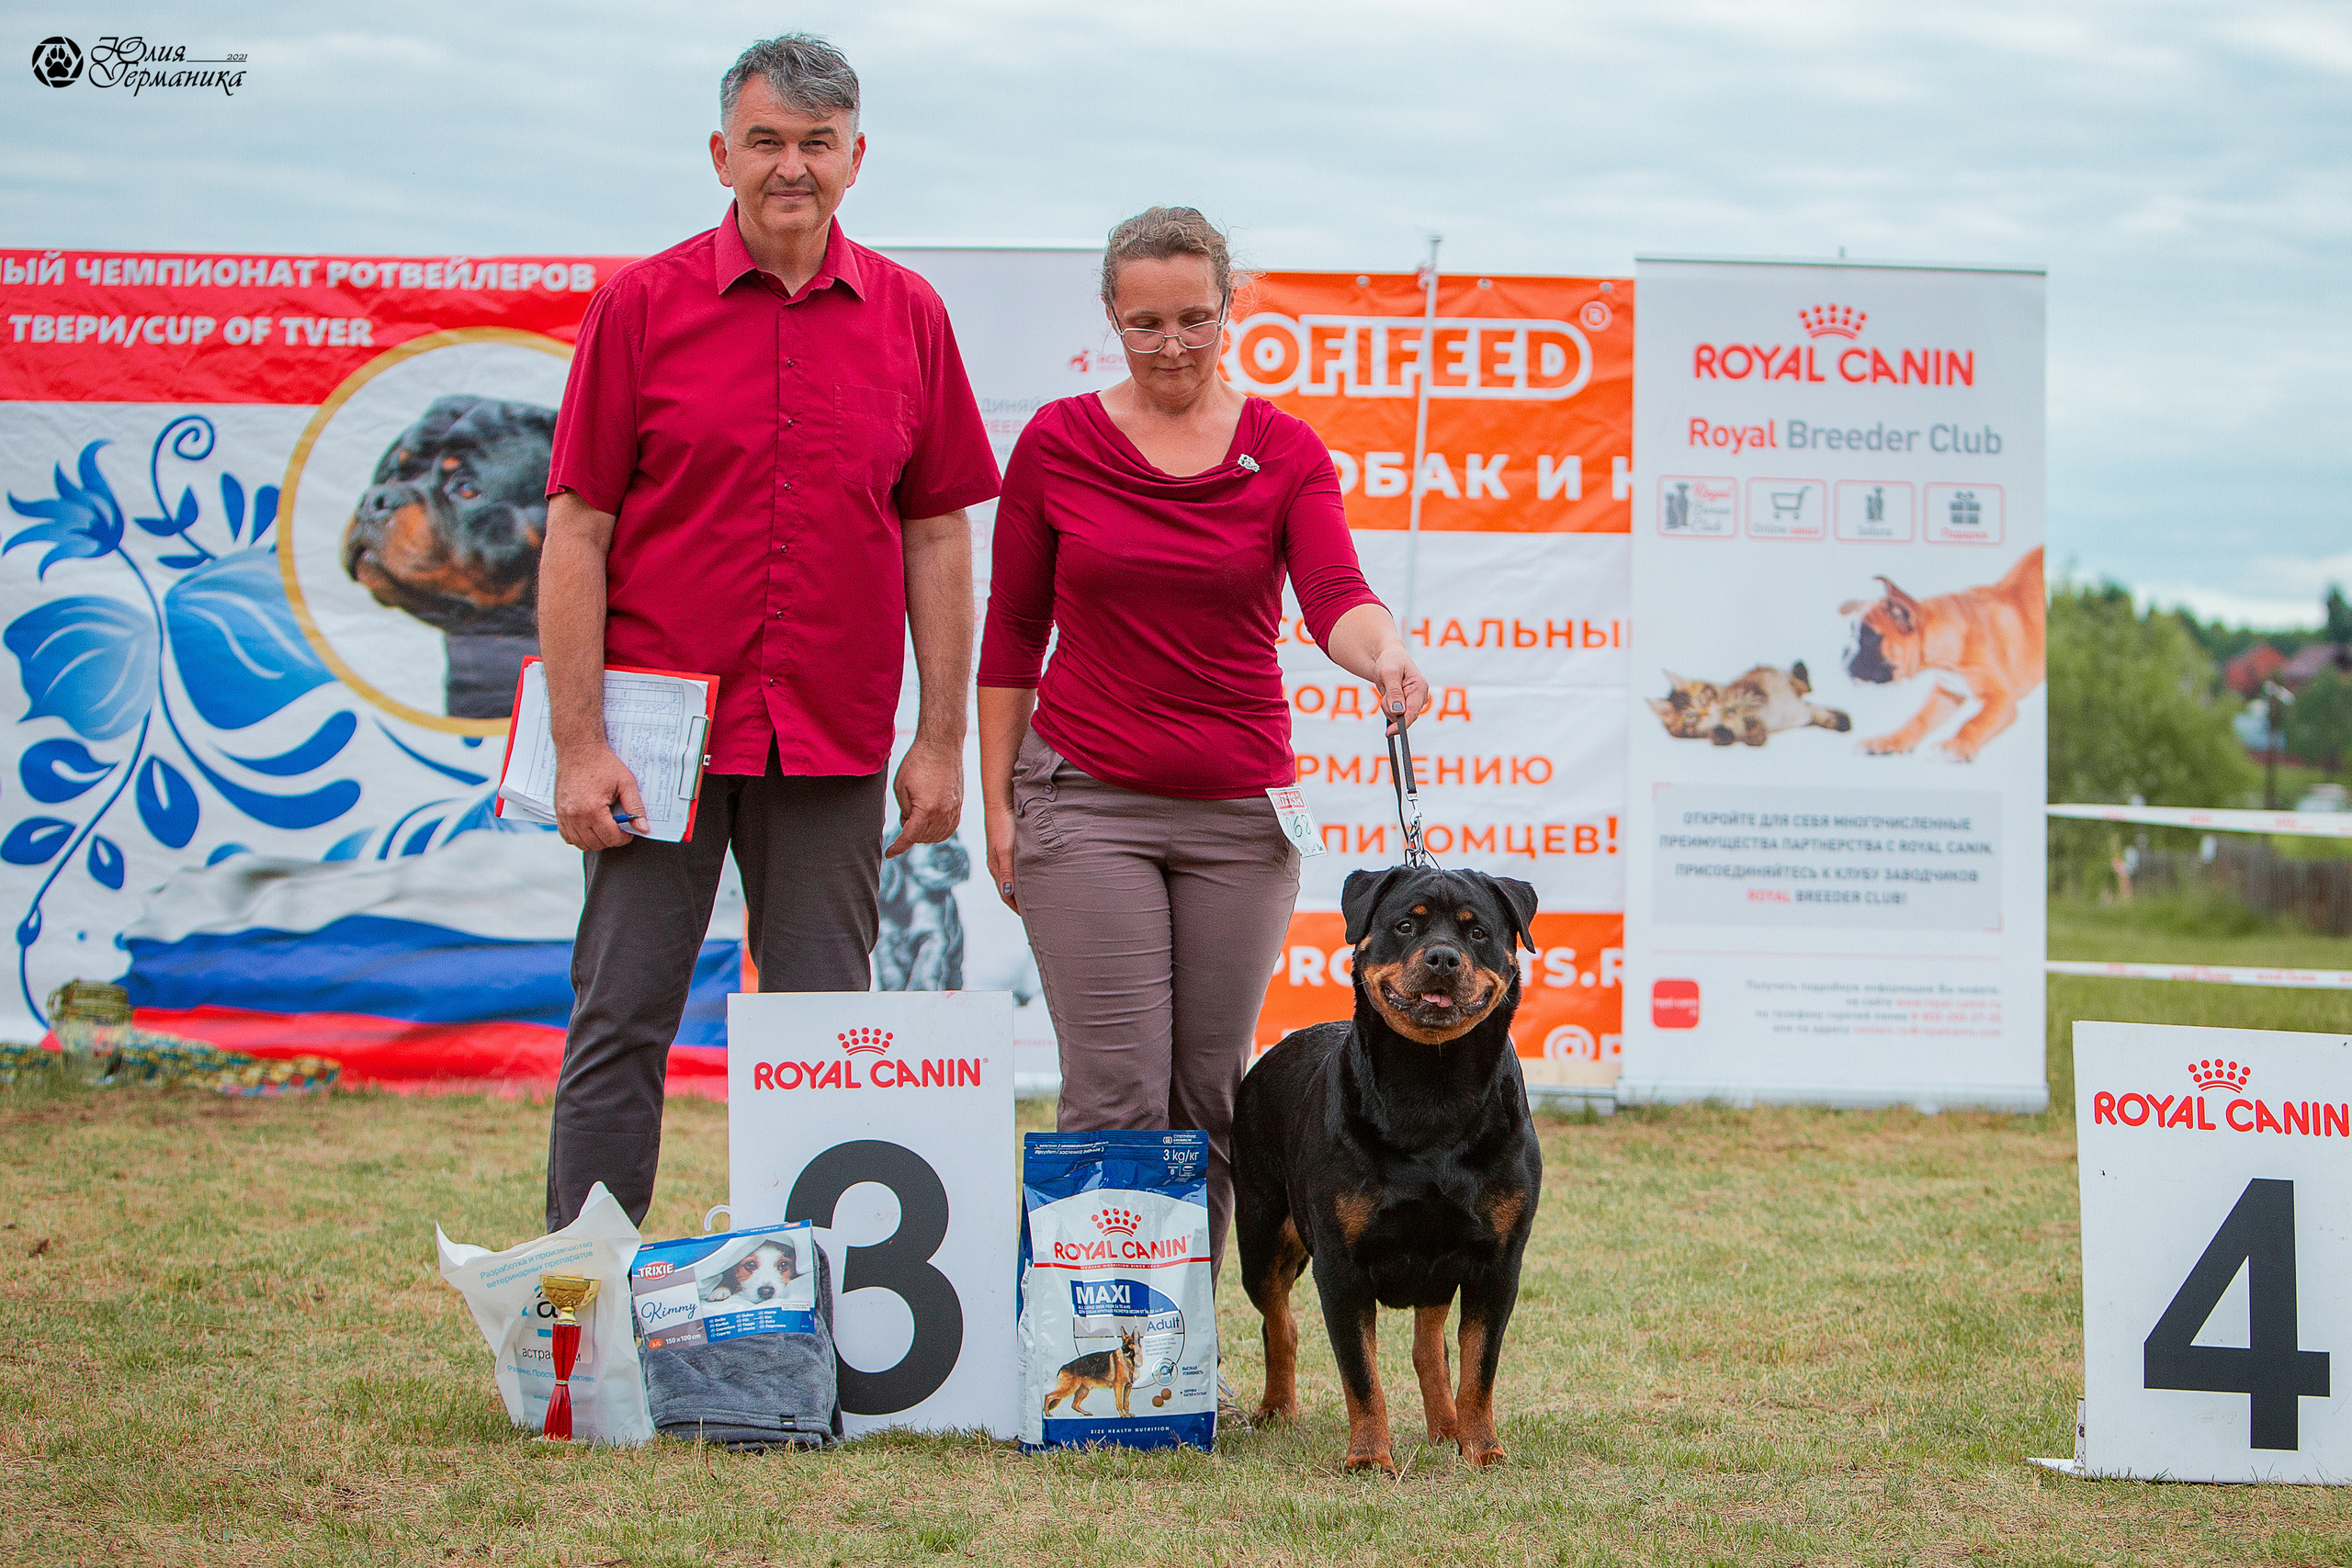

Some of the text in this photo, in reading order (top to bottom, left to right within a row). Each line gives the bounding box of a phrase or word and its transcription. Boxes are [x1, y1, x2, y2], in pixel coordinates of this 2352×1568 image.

[0, 250, 596, 292] ЫЙ ЧЕМПИОНАТ РОТВЕЙЛЕРОВ
[223, 316, 272, 345] OF
[279, 317, 374, 347] TVER
[1694, 343, 1974, 388] ROYAL CANIN
[1689, 417, 2003, 455] Royal Breeder Club
[1537, 455, 1583, 501] И
[1295, 754, 1554, 785] РМЛЕНИЮ
[754, 1057, 981, 1090] ROYAL CANIN
[2094, 1090, 2350, 1138] ROYAL CANIN
[1163, 1148, 1170, 1161] 3
[480, 1258, 527, 1280] Разработка
[535, 1241, 594, 1261] производство
[1054, 1235, 1187, 1261] ROYAL CANIN
[486, 1251, 594, 1289] ветеринарных препаратов
[639, 1263, 674, 1278] TRIXIE
[785, 1139, 964, 1416] 3
[1075, 1284, 1131, 1304] MAXI
[640, 1302, 697, 1324] Kimmy
[1147, 1316, 1181, 1332] Adult
[2143, 1177, 2331, 1451] 4
[665, 1337, 675, 1345] 150
